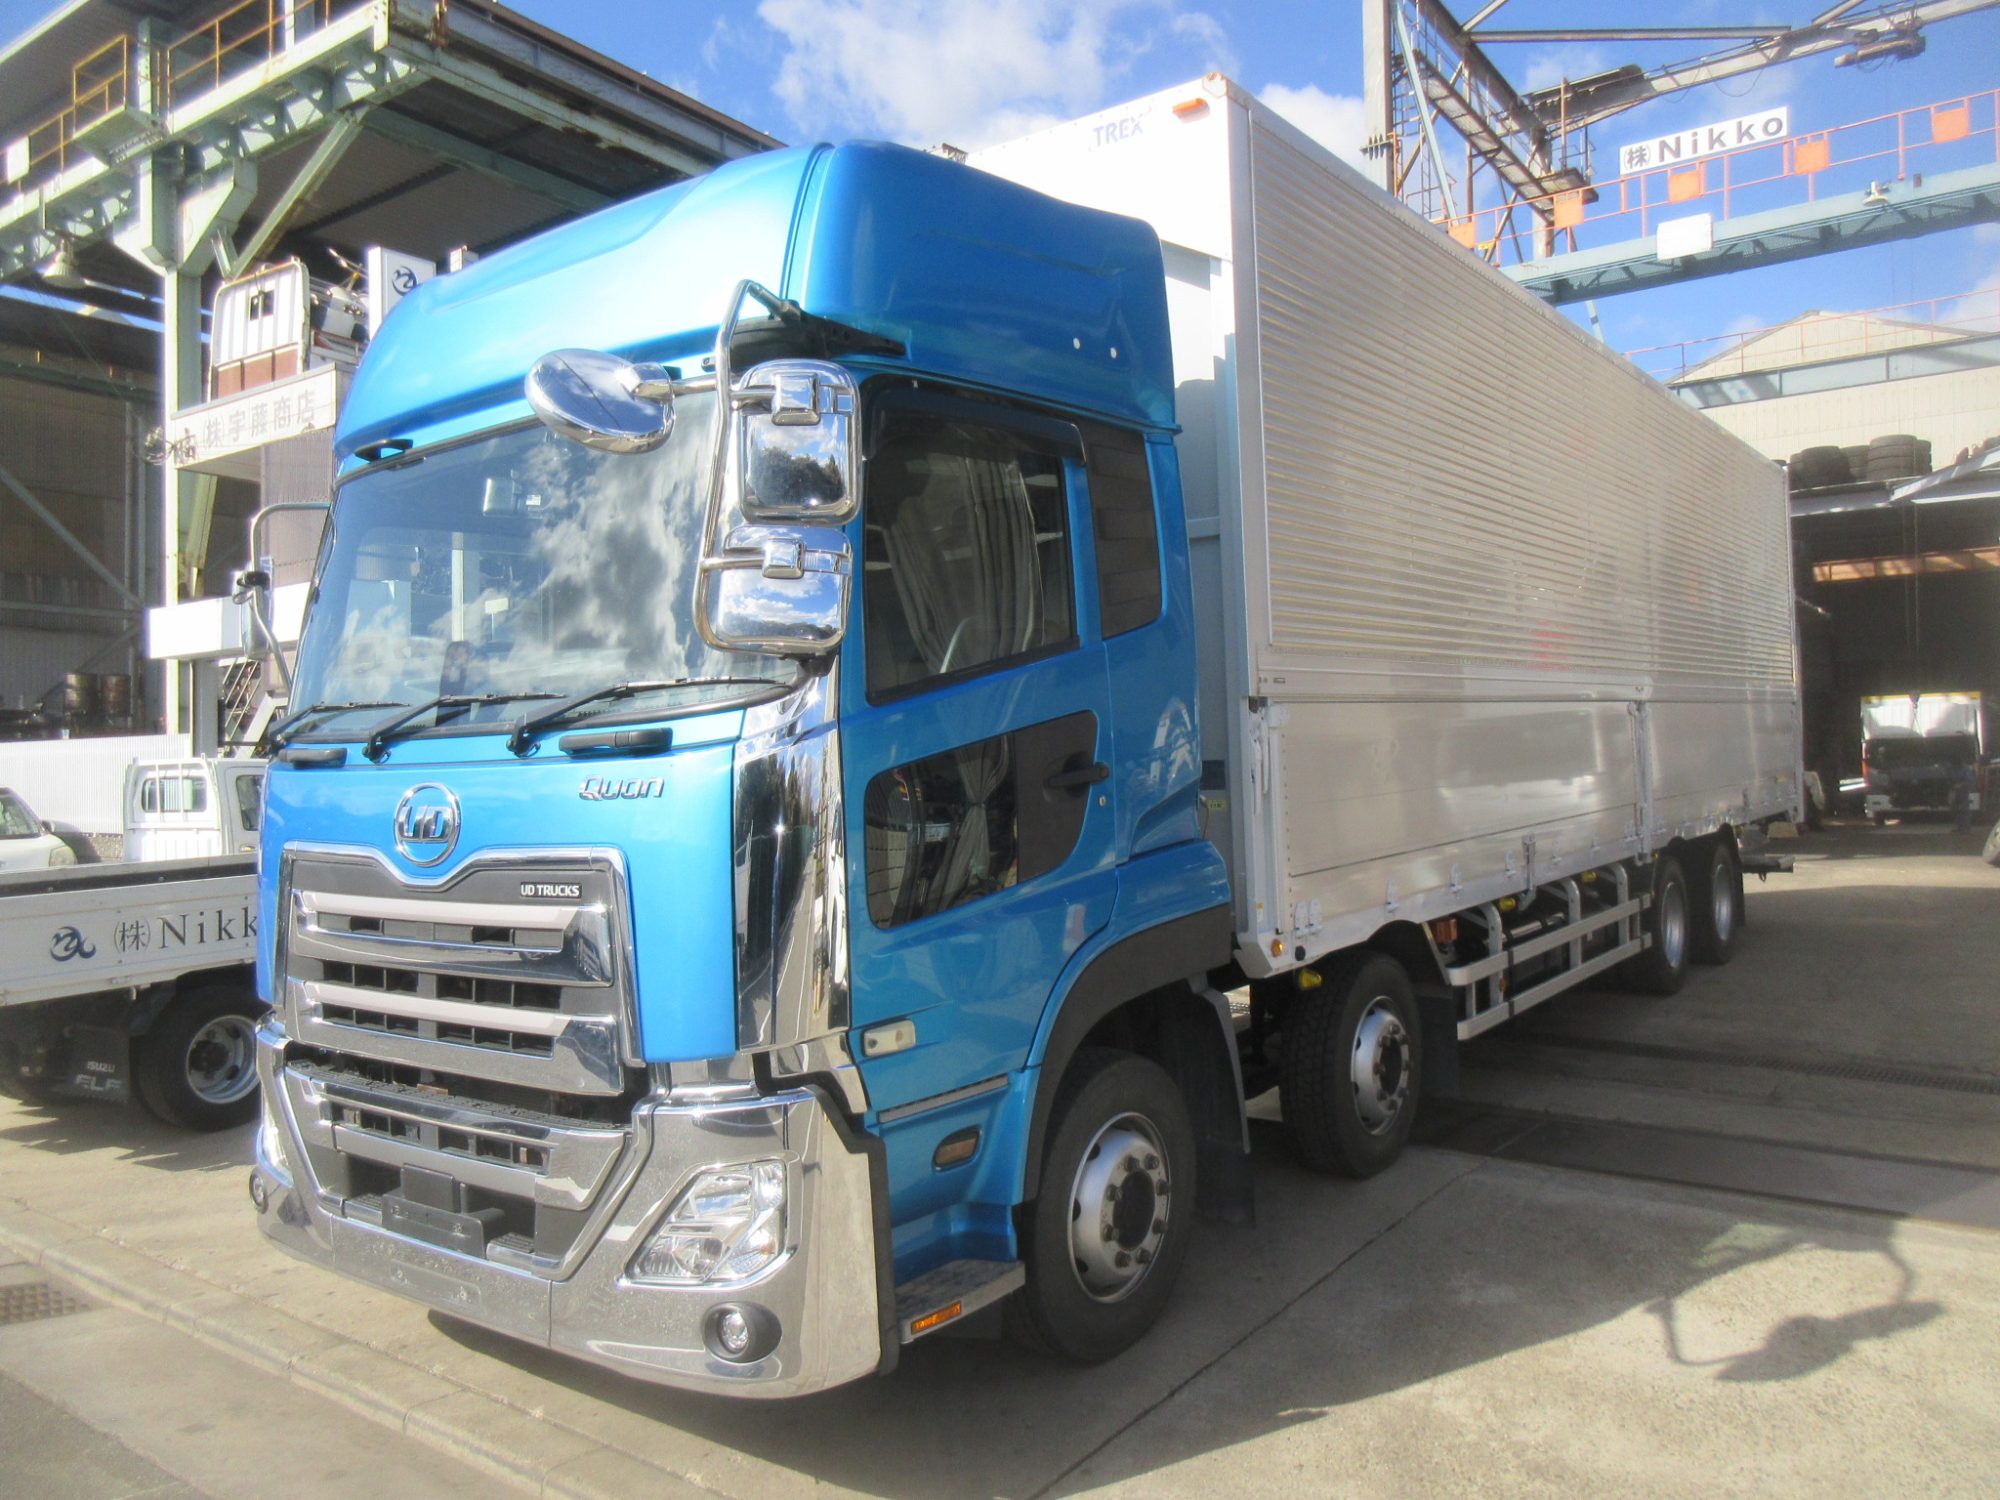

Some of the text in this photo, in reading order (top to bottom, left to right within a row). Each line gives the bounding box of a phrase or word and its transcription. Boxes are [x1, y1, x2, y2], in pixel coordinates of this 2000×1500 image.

[1091, 116, 1144, 147] TREX
[579, 775, 664, 801] Quon
[399, 806, 452, 843] UD
[520, 883, 580, 898] UD TRUCKS
